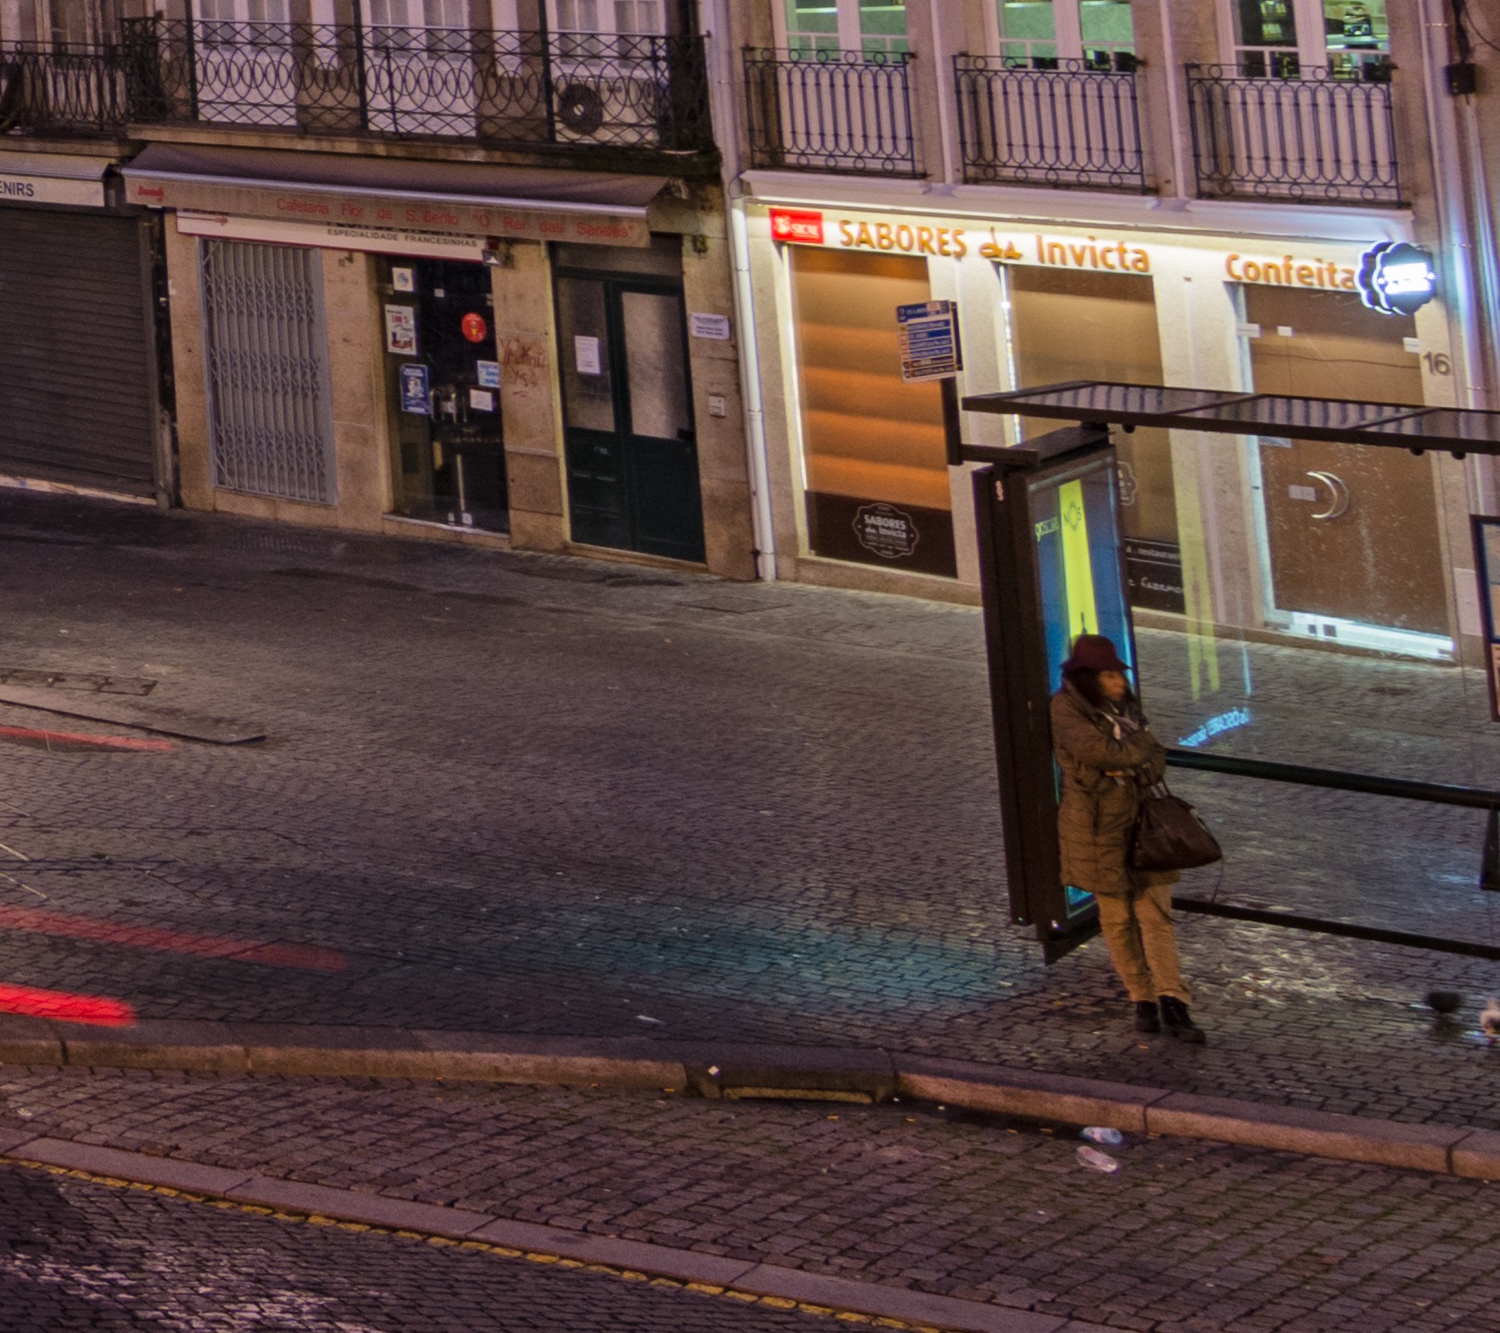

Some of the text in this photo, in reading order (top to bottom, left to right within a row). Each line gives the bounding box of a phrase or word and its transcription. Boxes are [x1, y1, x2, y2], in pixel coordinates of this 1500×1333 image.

[327, 228, 399, 241] ESPECIALIDADE
[404, 234, 478, 247] FRANCESINHAS
[839, 220, 1150, 272] SABORES da Invicta
[1225, 253, 1358, 291] Confeita
[1423, 351, 1450, 376] 16
